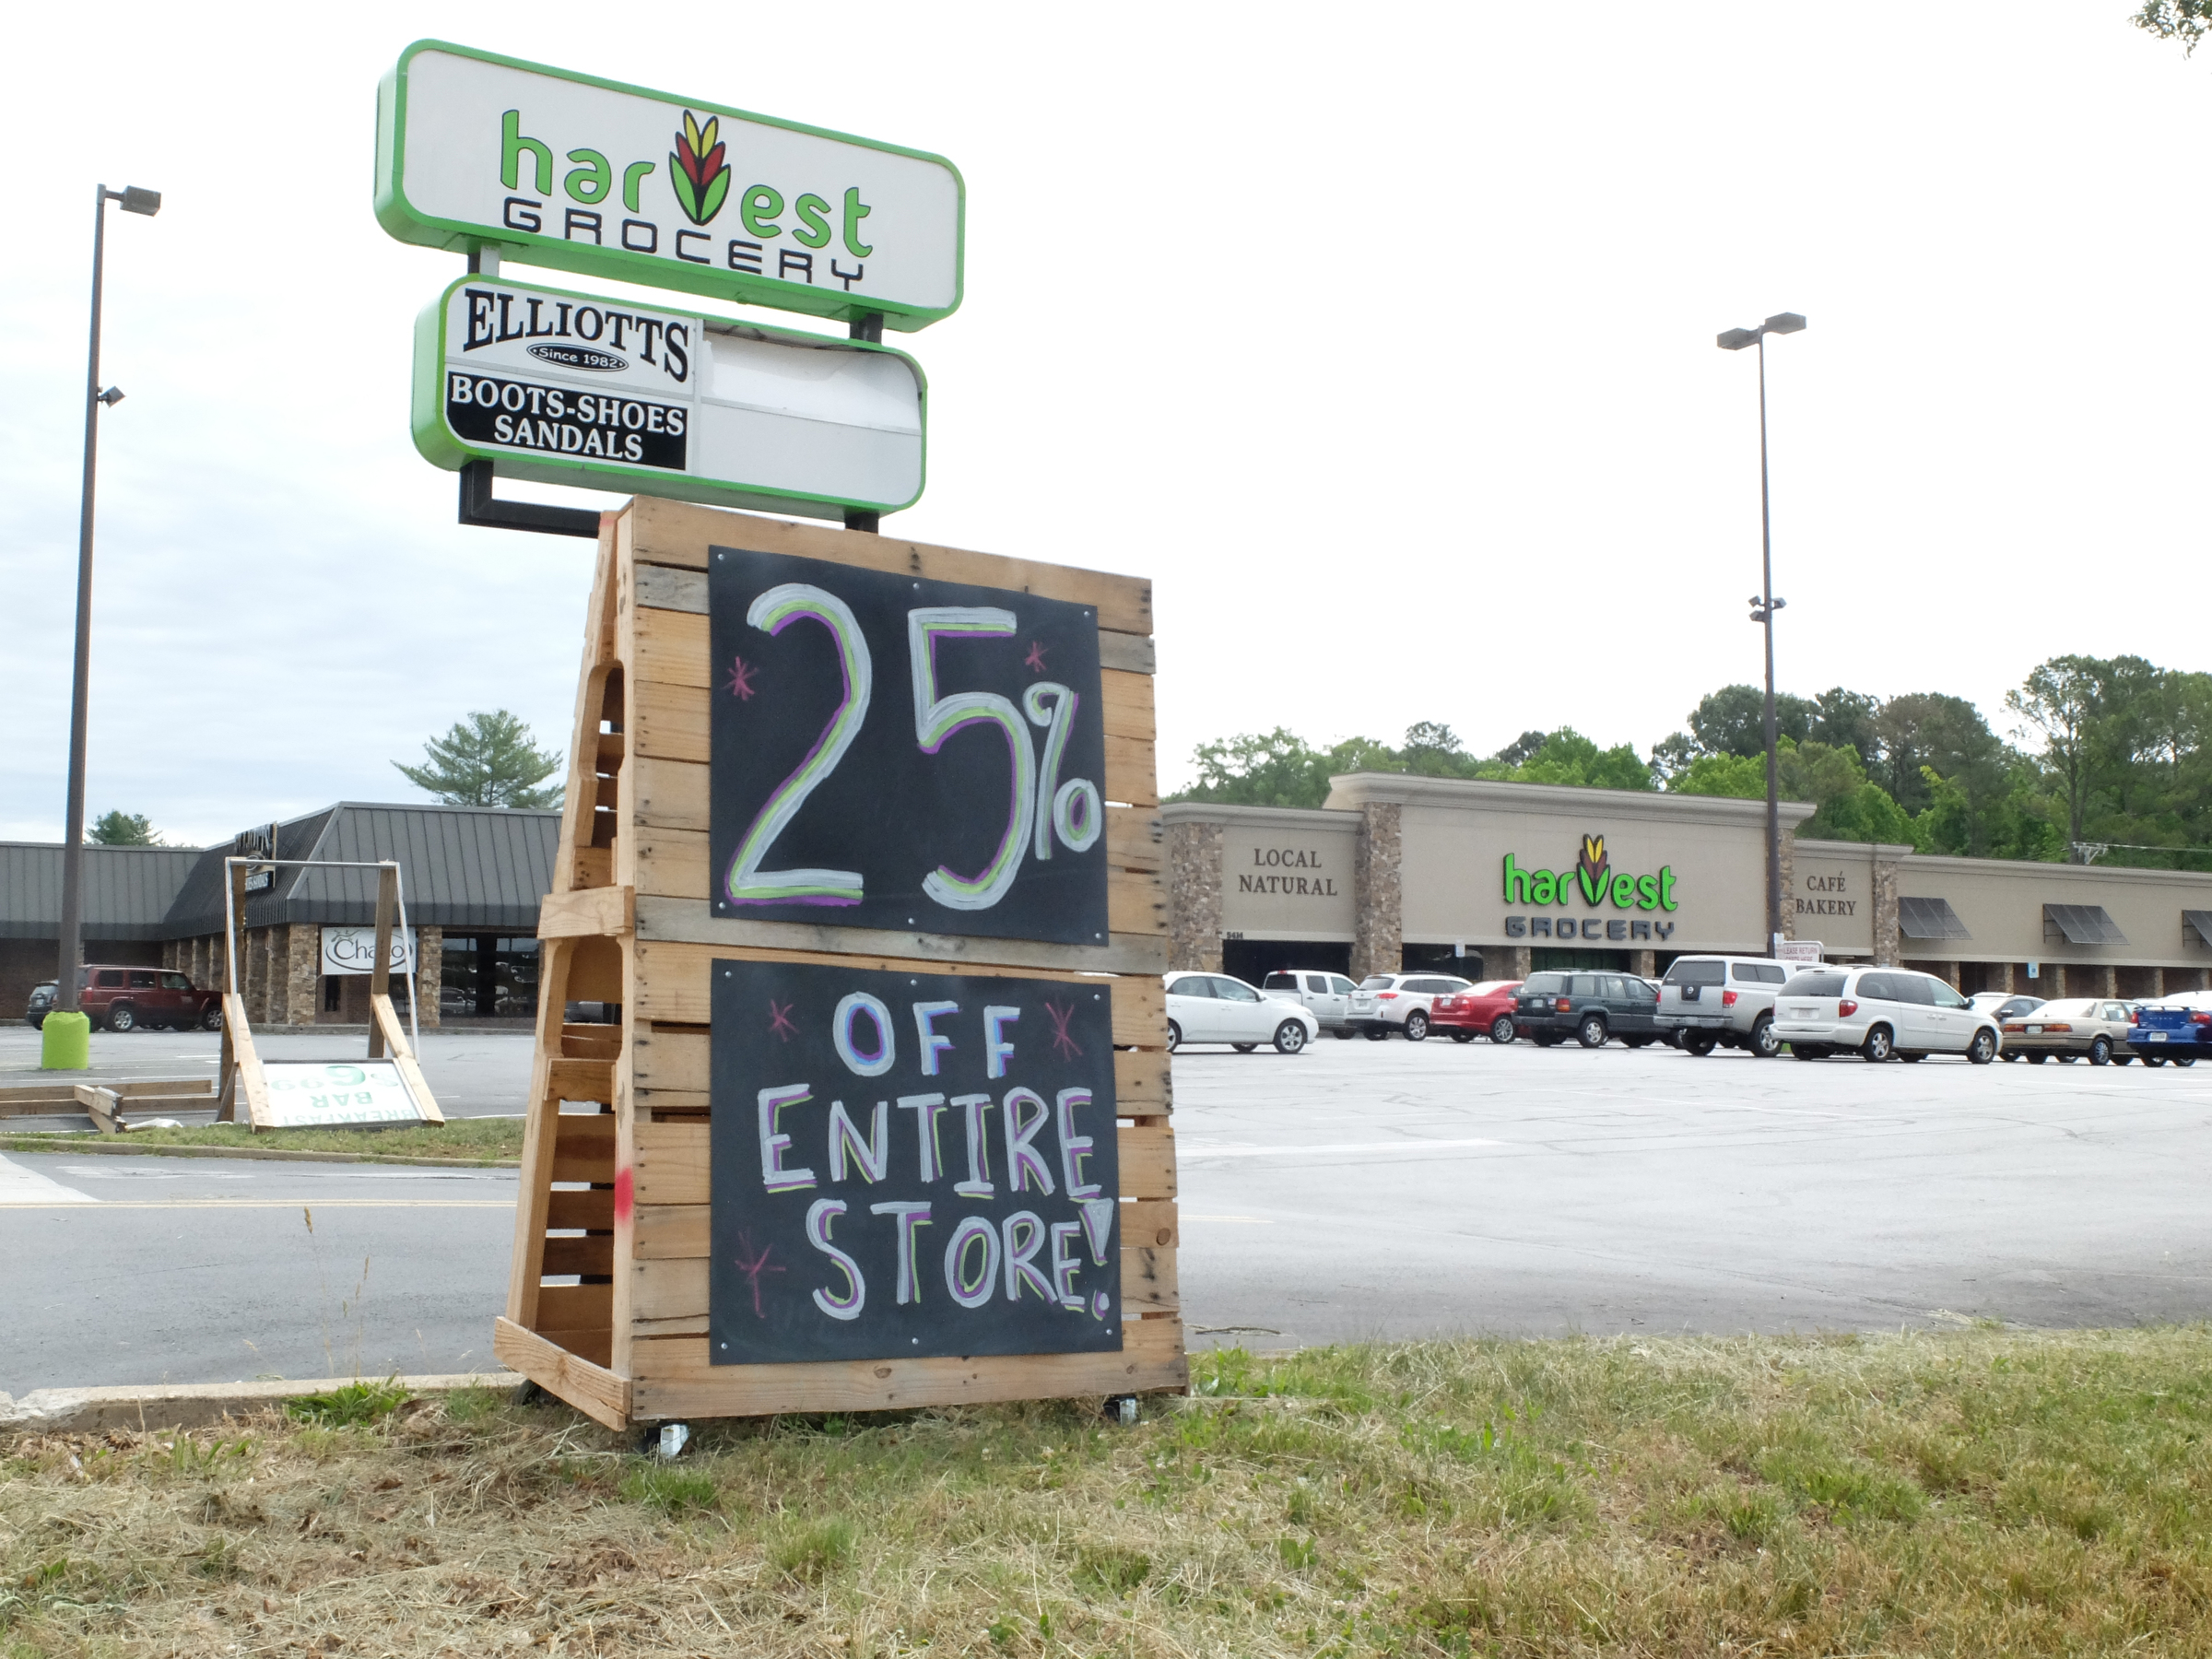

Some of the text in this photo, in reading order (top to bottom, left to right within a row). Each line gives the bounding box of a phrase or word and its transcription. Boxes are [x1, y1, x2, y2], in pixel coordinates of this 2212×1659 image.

[503, 196, 865, 291] GROCERY
[464, 288, 688, 383] ELLIOTTS
[539, 347, 618, 369] Since 1982
[452, 375, 684, 436] BOOTS-SHOES
[494, 415, 643, 461] SANDALS
[724, 582, 1101, 911] 25%
[1253, 848, 1322, 868] LOCAL
[1239, 875, 1337, 896] NATURAL
[1806, 871, 1846, 892] CAFÉ
[1795, 899, 1856, 915] BAKERY
[1505, 916, 1675, 941] GROCERY
[334, 939, 405, 960] Chao
[1784, 947, 1798, 955] LEASE
[832, 992, 1021, 1078] OFF
[309, 1091, 373, 1108] BAR
[758, 1083, 1102, 1204] ENTIRE
[806, 1197, 1114, 1321] STORE!
